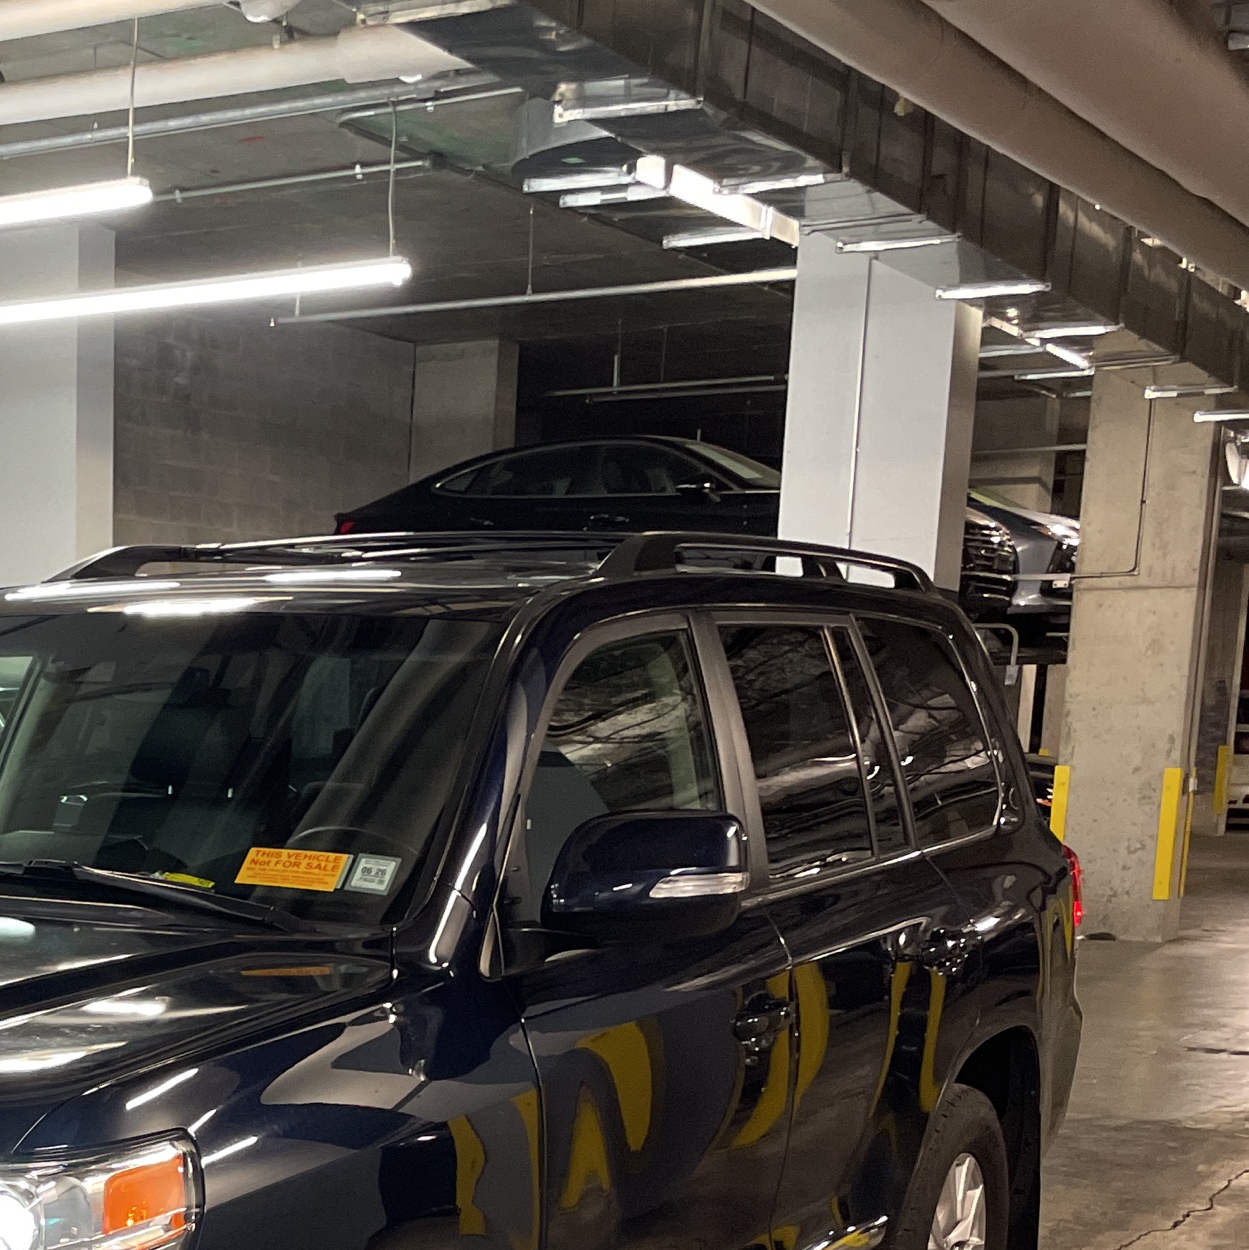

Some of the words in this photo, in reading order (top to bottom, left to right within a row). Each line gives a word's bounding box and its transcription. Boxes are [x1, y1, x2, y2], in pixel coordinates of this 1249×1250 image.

[254, 849, 283, 859] THIS
[286, 852, 343, 864] VEHICLE
[250, 858, 271, 867] Not
[274, 860, 302, 869] FOR
[304, 862, 341, 873] SALE
